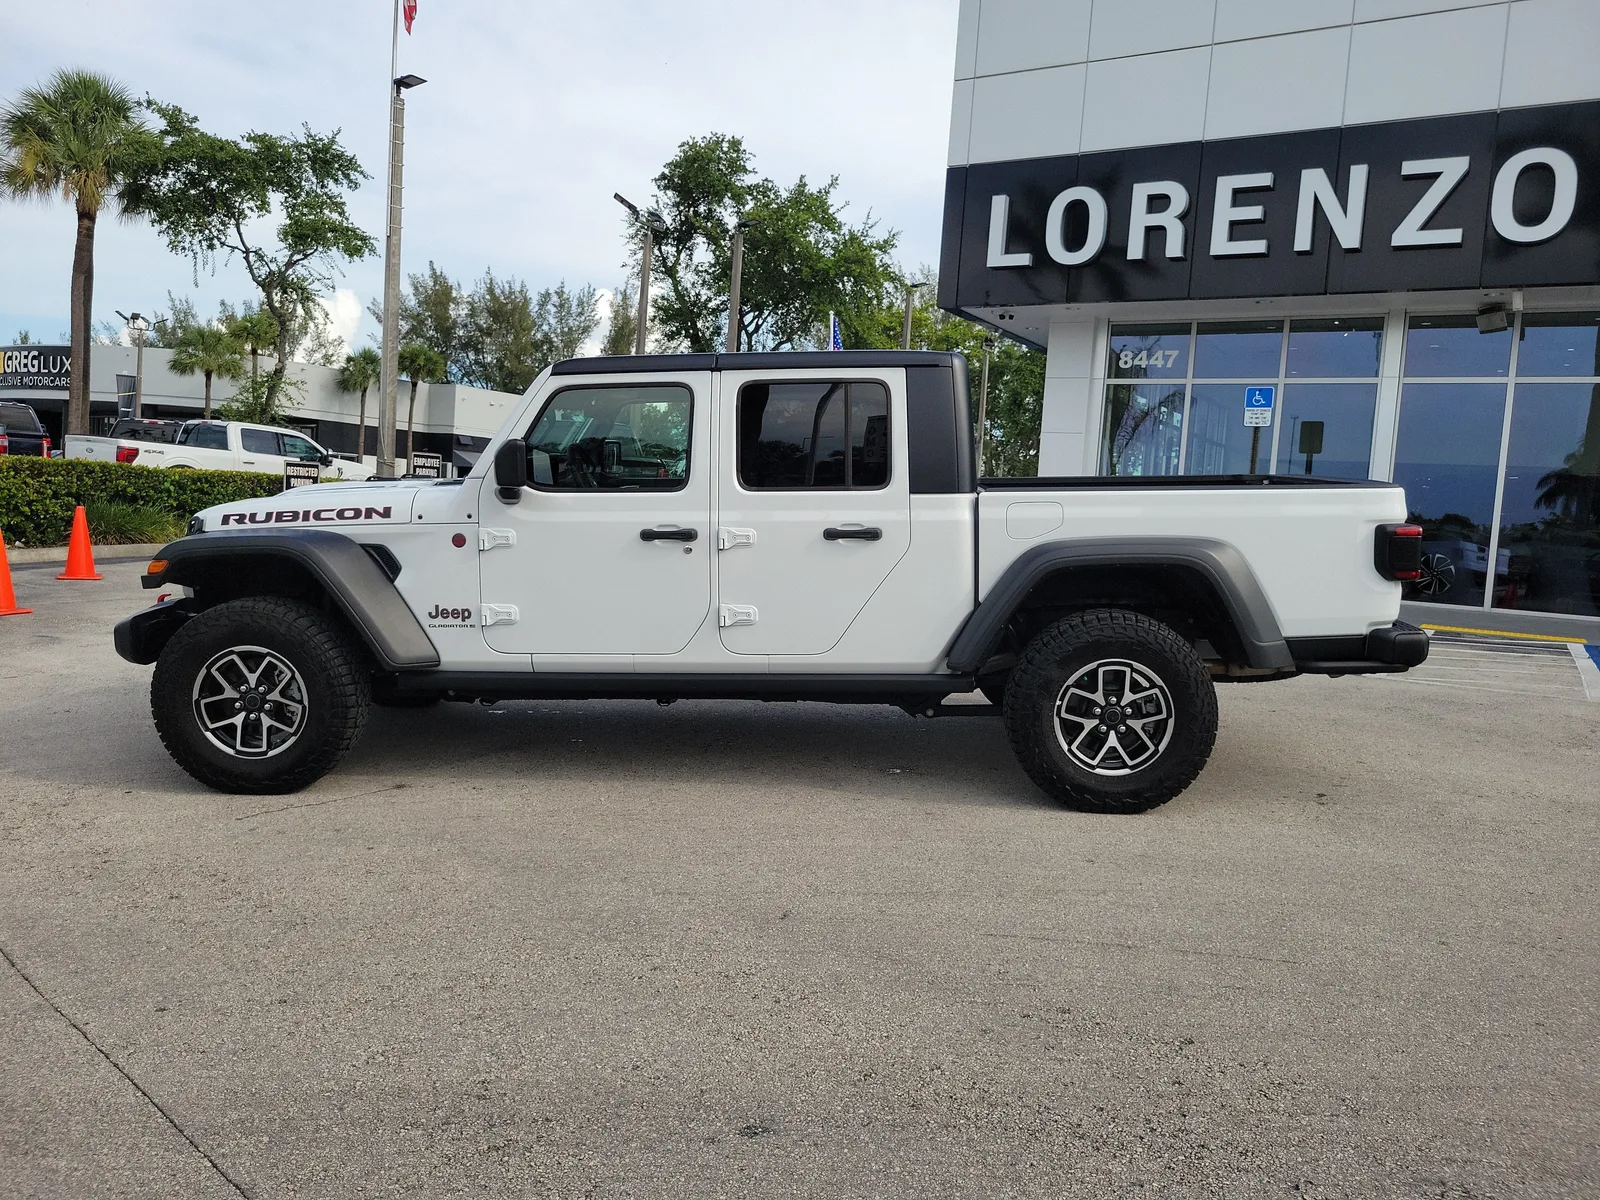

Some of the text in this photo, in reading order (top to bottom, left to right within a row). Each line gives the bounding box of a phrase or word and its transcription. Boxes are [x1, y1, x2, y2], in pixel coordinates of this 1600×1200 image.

[985, 146, 1579, 270] LORENZO
[1118, 349, 1180, 369] 8447
[413, 457, 440, 468] EMPLOYEE
[286, 466, 319, 478] RESTRICTED
[415, 467, 438, 478] PARKING
[290, 478, 314, 488] PARKING
[220, 506, 393, 526] RUBICON
[428, 604, 472, 622] Jeep
